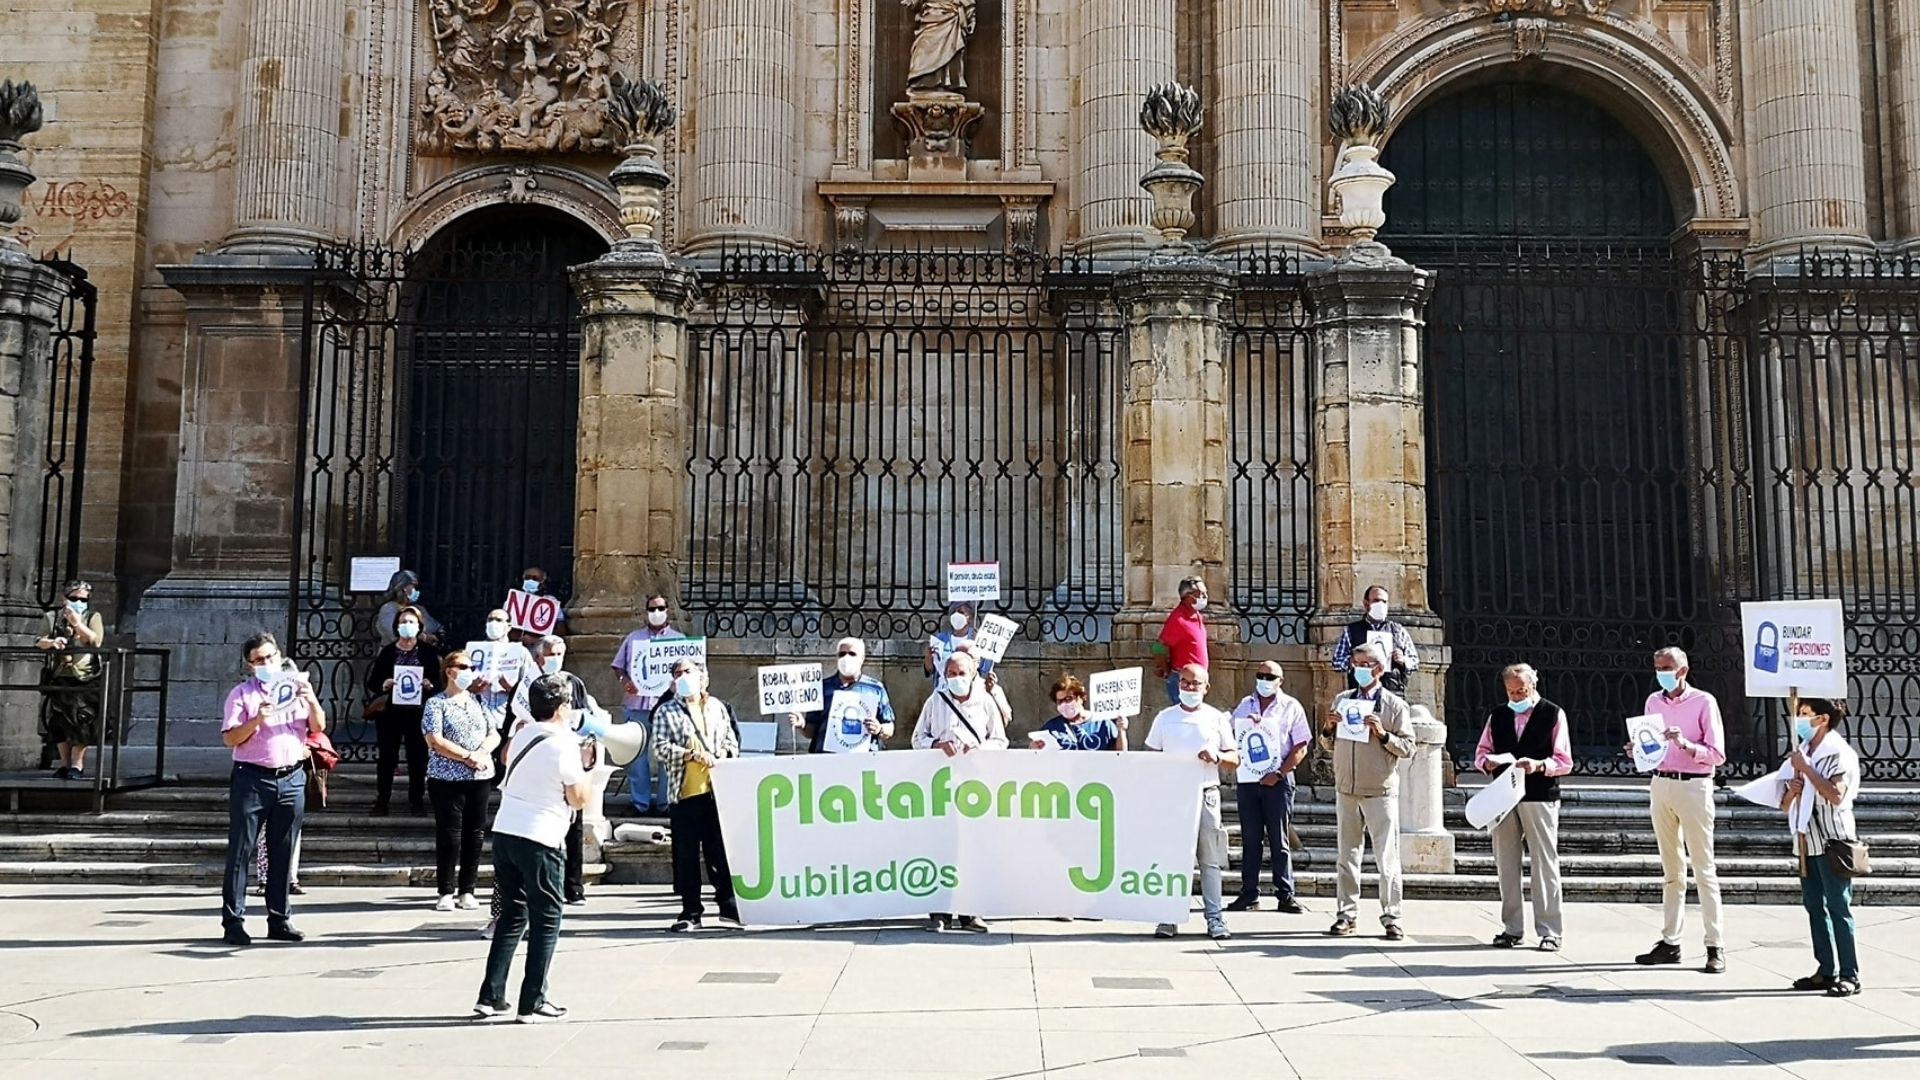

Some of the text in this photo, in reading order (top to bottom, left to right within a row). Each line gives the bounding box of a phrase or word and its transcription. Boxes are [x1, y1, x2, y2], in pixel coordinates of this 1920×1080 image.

[506, 590, 556, 632] NO
[649, 646, 662, 659] LA
[1788, 641, 1831, 656] PENSIONES
[649, 663, 660, 675] MI
[762, 672, 790, 687] ROBAR
[1109, 678, 1137, 693] PENSNES
[764, 692, 775, 706] ES
[732, 858, 1188, 900] Jubilad@s Jaén
